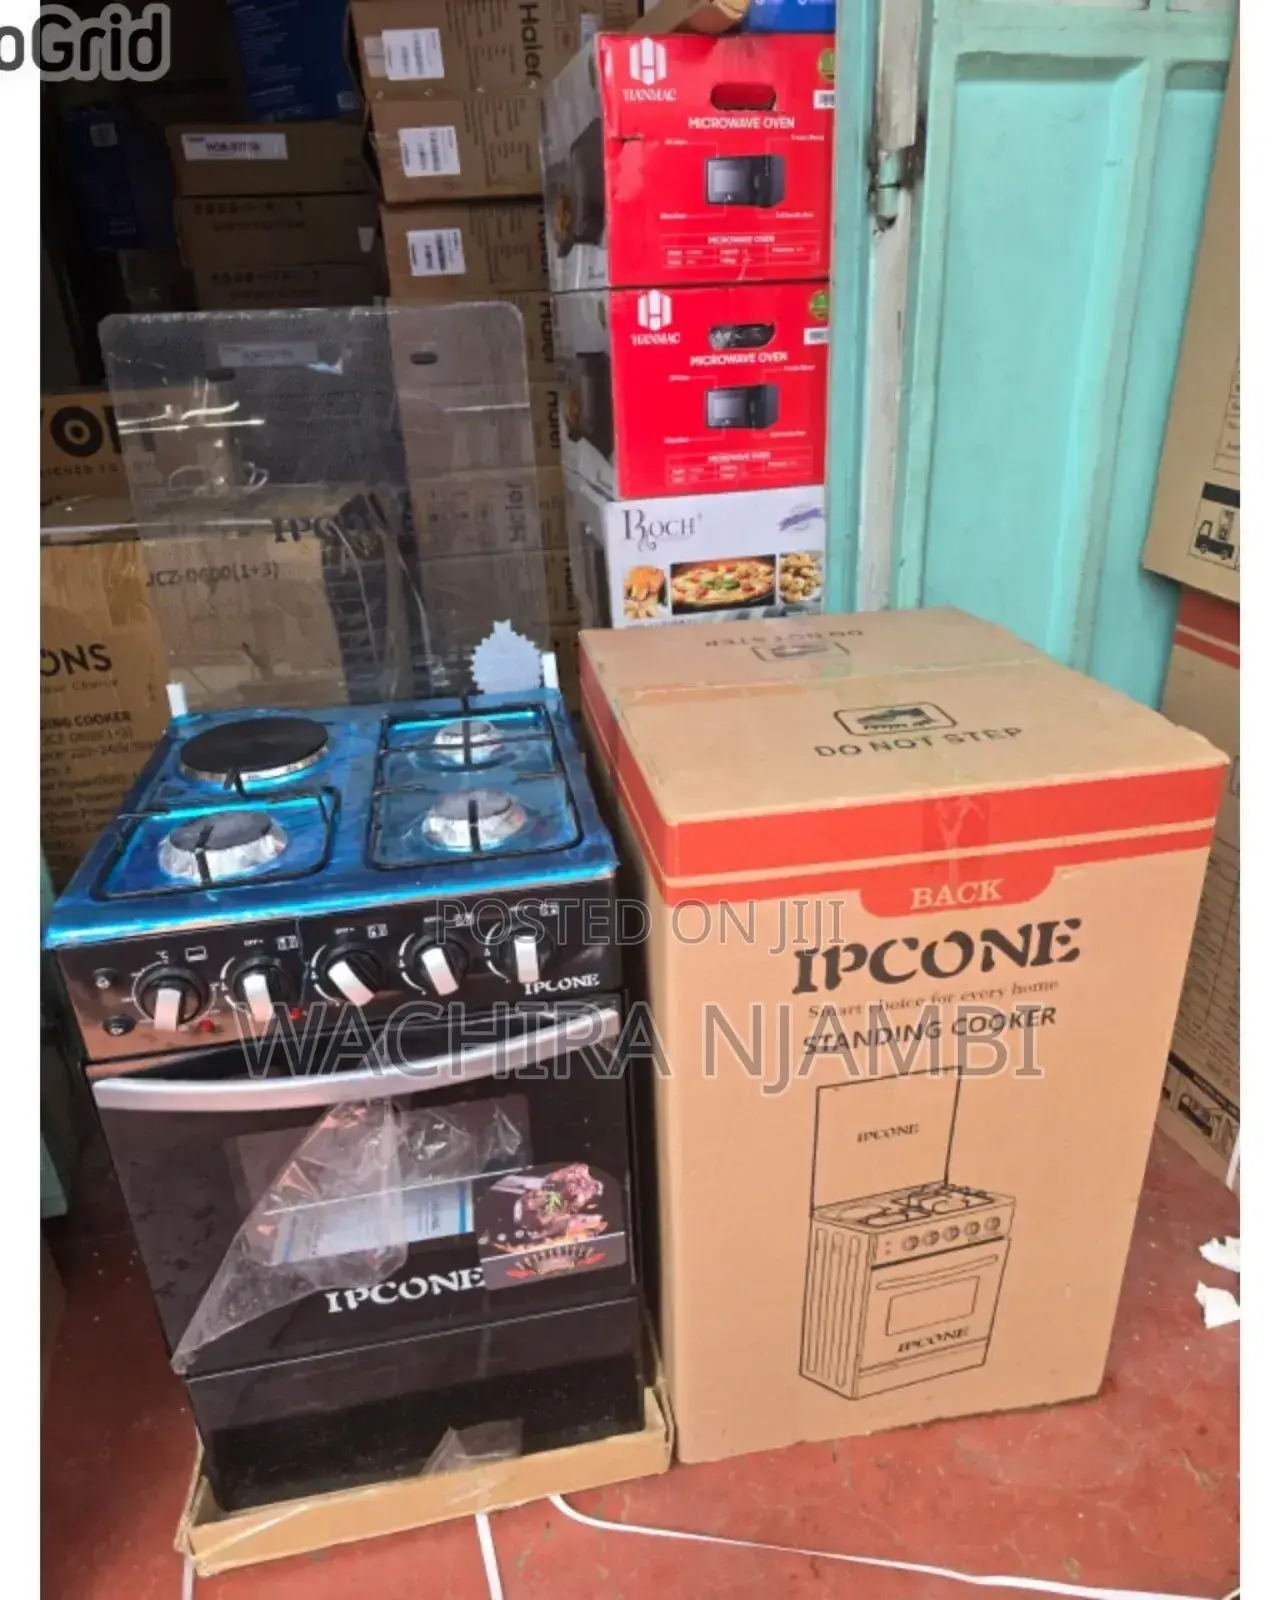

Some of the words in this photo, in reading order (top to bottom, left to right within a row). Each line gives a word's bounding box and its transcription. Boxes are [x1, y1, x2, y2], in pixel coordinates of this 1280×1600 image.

[519, 3, 543, 79] Haier
[688, 117, 760, 130] MICROWAVE
[763, 117, 795, 128] OVEN
[690, 354, 756, 367] MICROWAVE
[758, 351, 788, 363] OVEN
[814, 744, 862, 757] DO
[869, 735, 934, 752] NOT
[943, 727, 1023, 745] STEP
[909, 878, 1005, 911] BACK
[792, 918, 1083, 996] IPCONE
[808, 1002, 862, 1020] Smart
[931, 991, 953, 1006] for
[960, 986, 1004, 1003] every
[1011, 979, 1060, 996] home
[803, 1020, 943, 1056] STANDING
[951, 1006, 1058, 1037] COOKER
[856, 1122, 920, 1144] IPCONE
[325, 1267, 486, 1315] IPCONE
[897, 1326, 970, 1353] IPCONE
